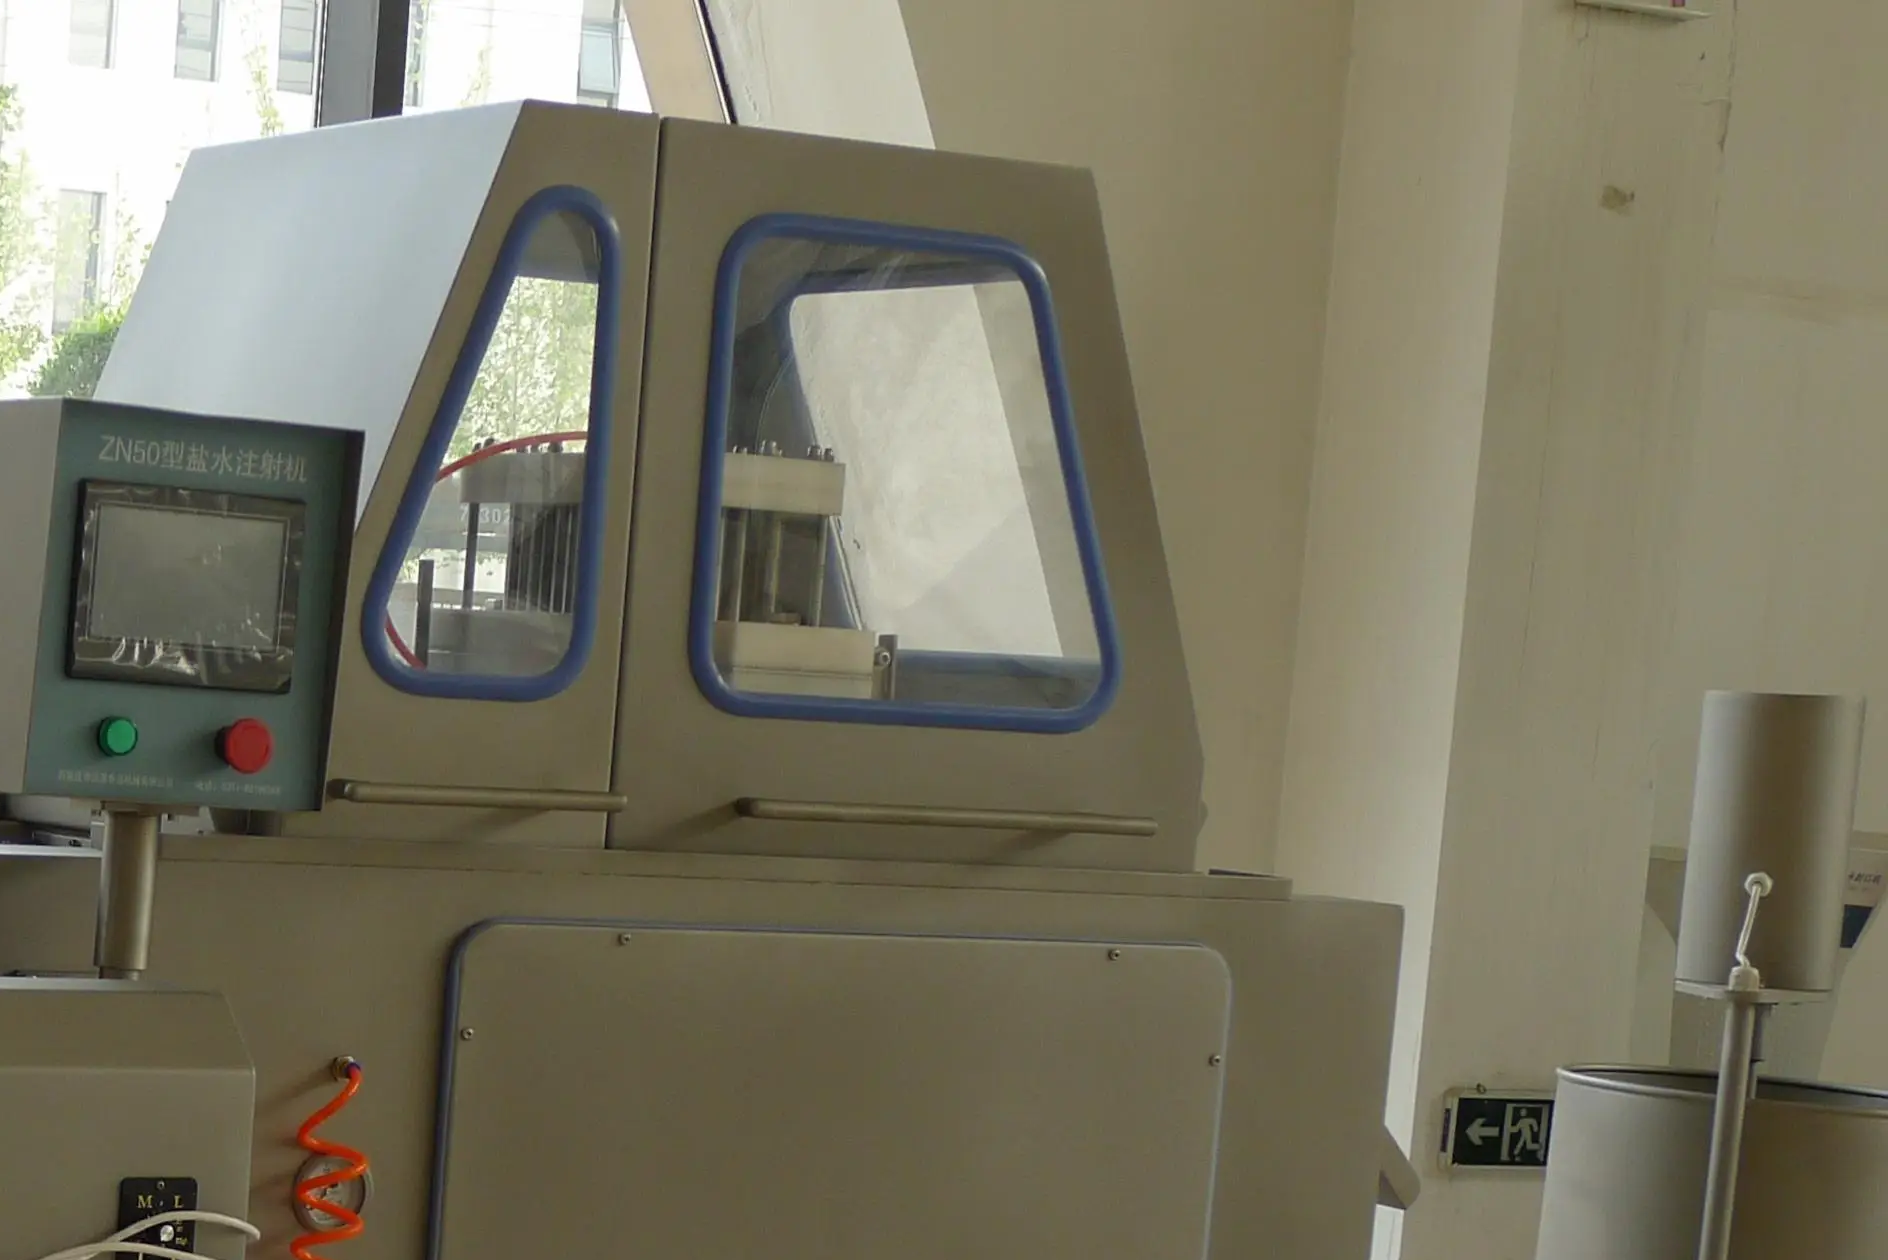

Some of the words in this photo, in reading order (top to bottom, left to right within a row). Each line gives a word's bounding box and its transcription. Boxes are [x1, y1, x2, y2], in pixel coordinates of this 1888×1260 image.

[97, 434, 308, 484] ZN50型盐水注射机
